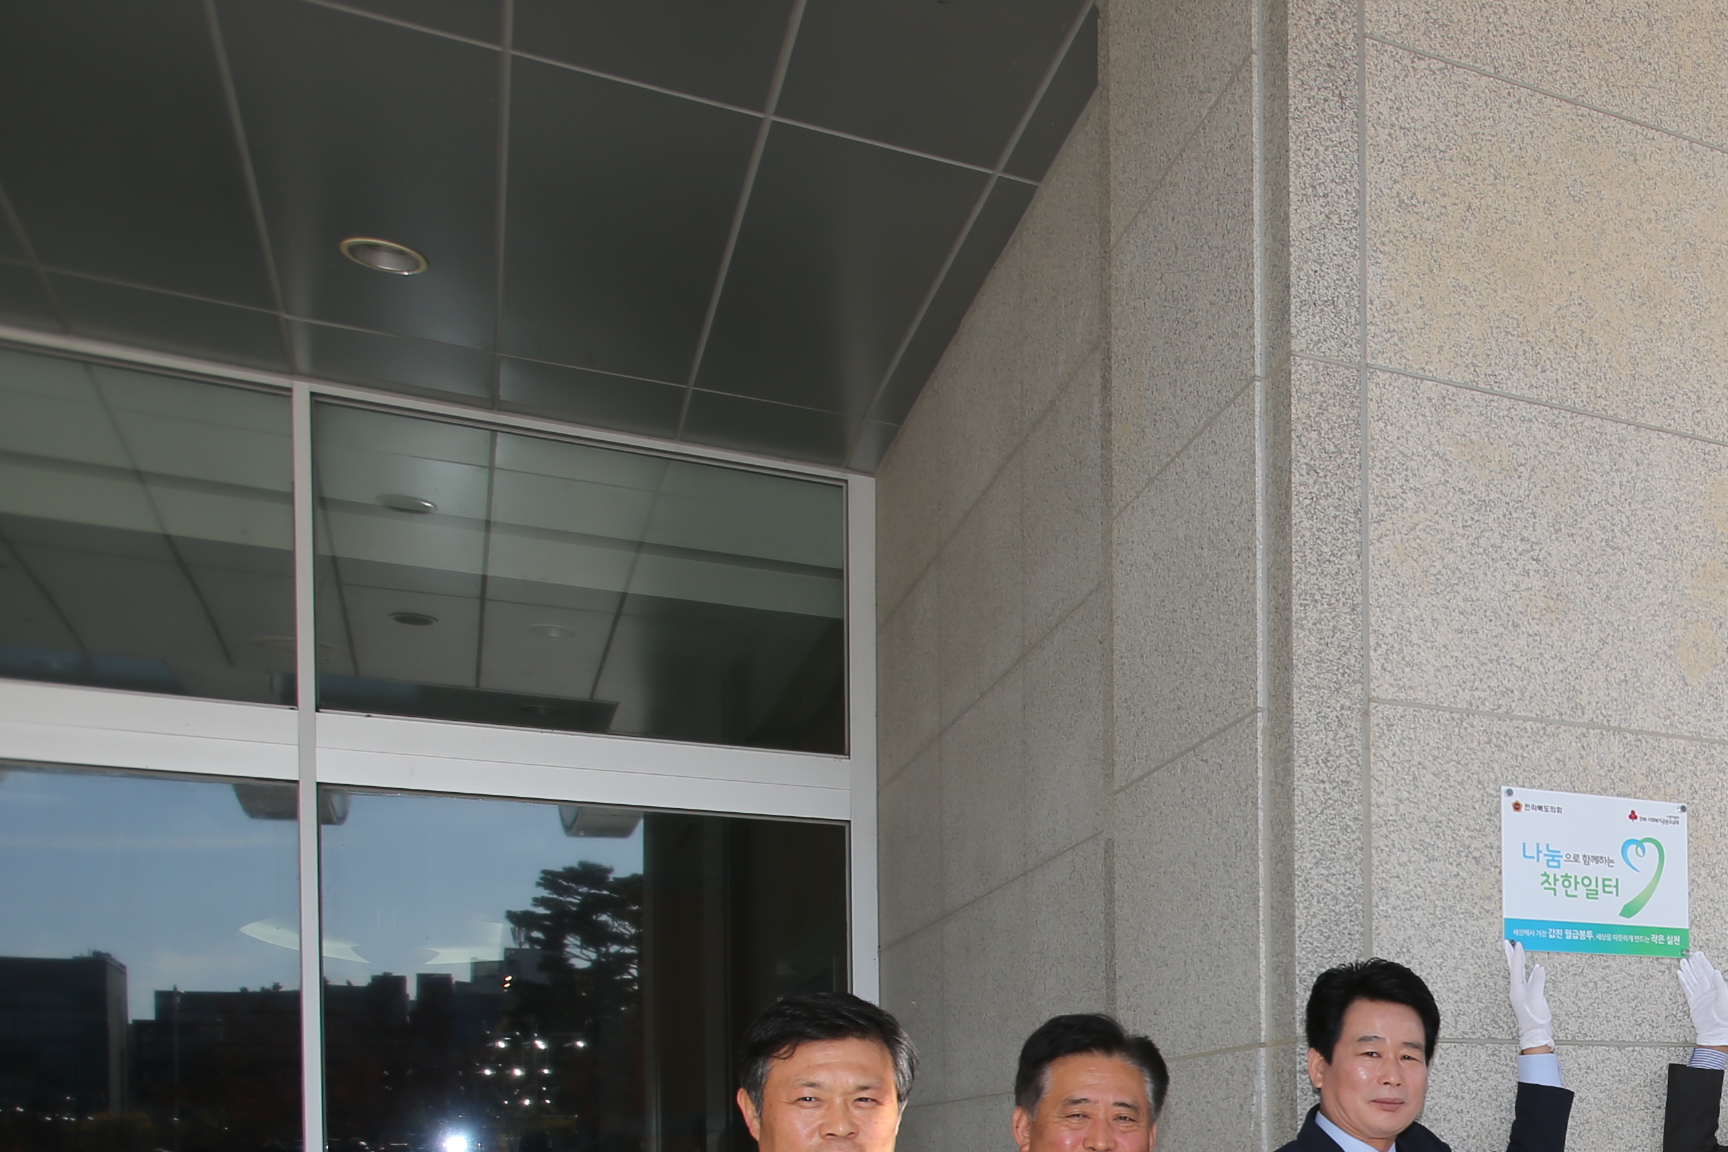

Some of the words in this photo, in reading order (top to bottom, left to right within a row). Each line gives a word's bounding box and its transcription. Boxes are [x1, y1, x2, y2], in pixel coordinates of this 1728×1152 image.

[1522, 842, 1580, 869] 나눔으로
[1582, 853, 1615, 868] 함께하는
[1540, 871, 1619, 900] 착한일터
[1548, 928, 1563, 939] 값진
